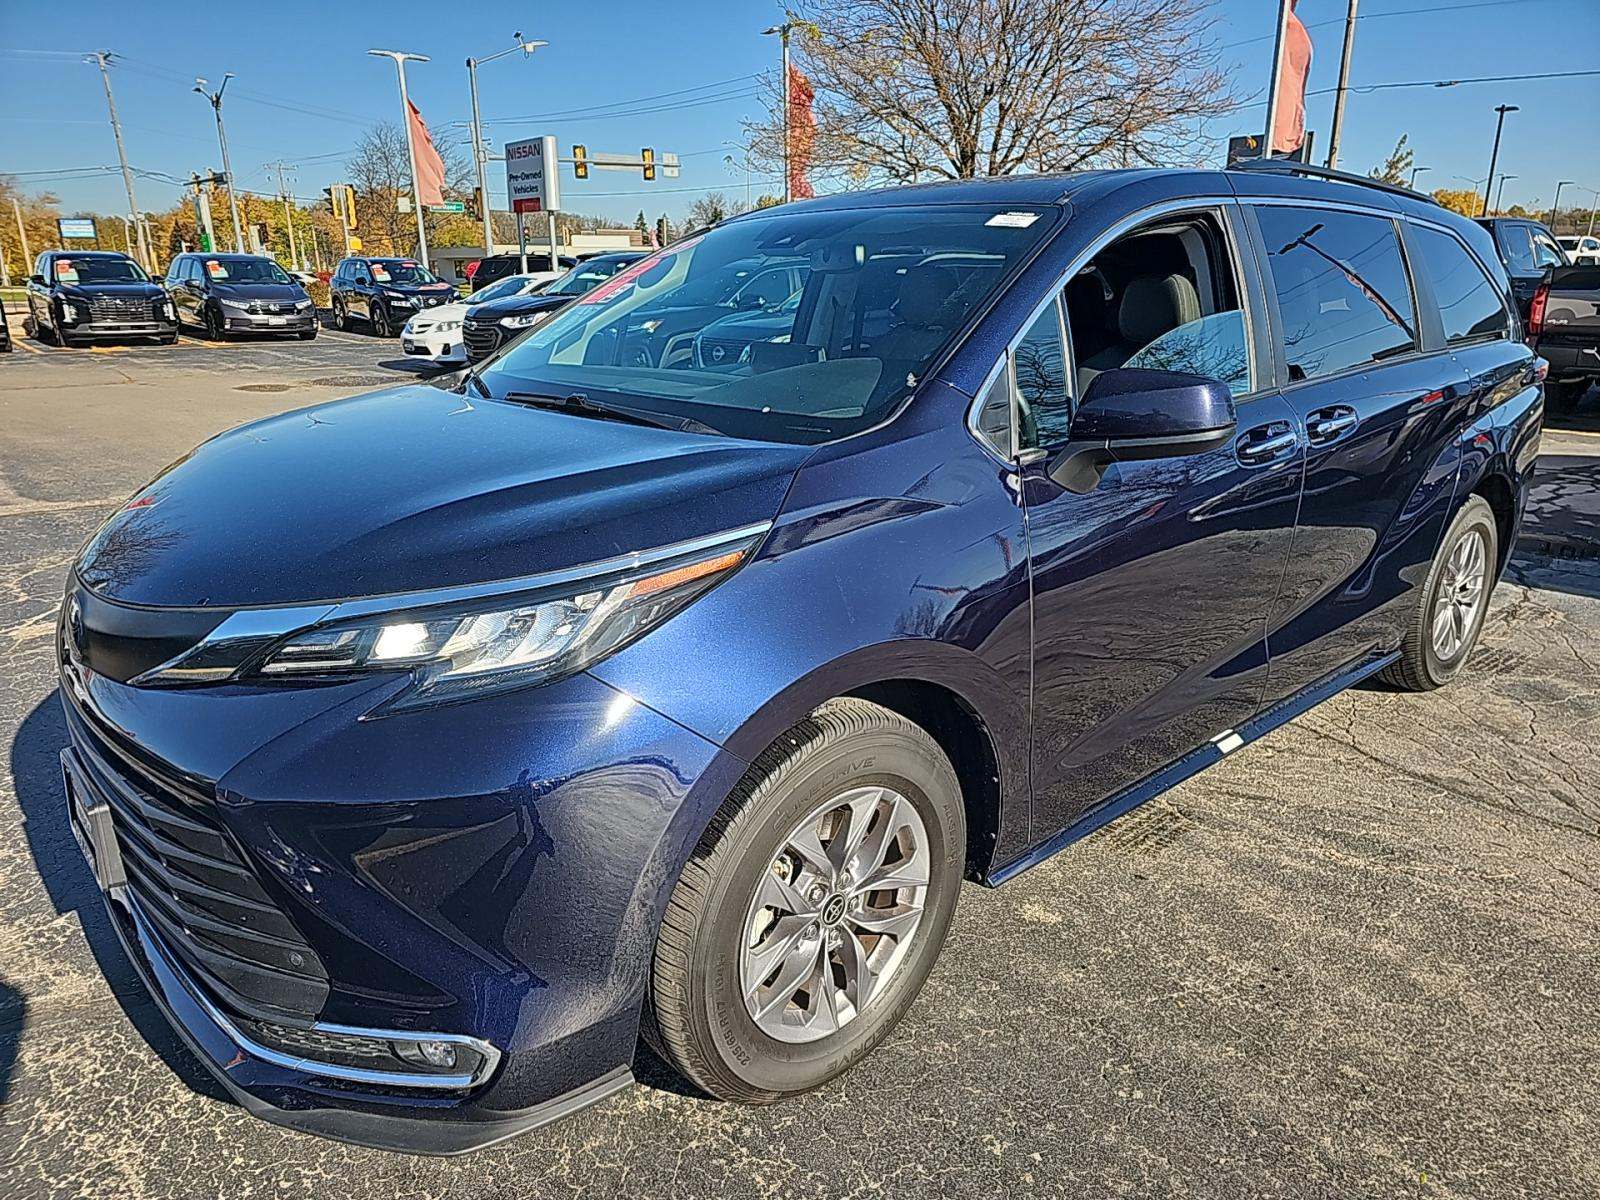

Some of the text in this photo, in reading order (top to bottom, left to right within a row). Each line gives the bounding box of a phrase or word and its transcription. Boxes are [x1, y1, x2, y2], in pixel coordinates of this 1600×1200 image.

[508, 143, 540, 160] NISSAN
[509, 170, 542, 182] Pre-Owned
[513, 184, 539, 194] Vehicles
